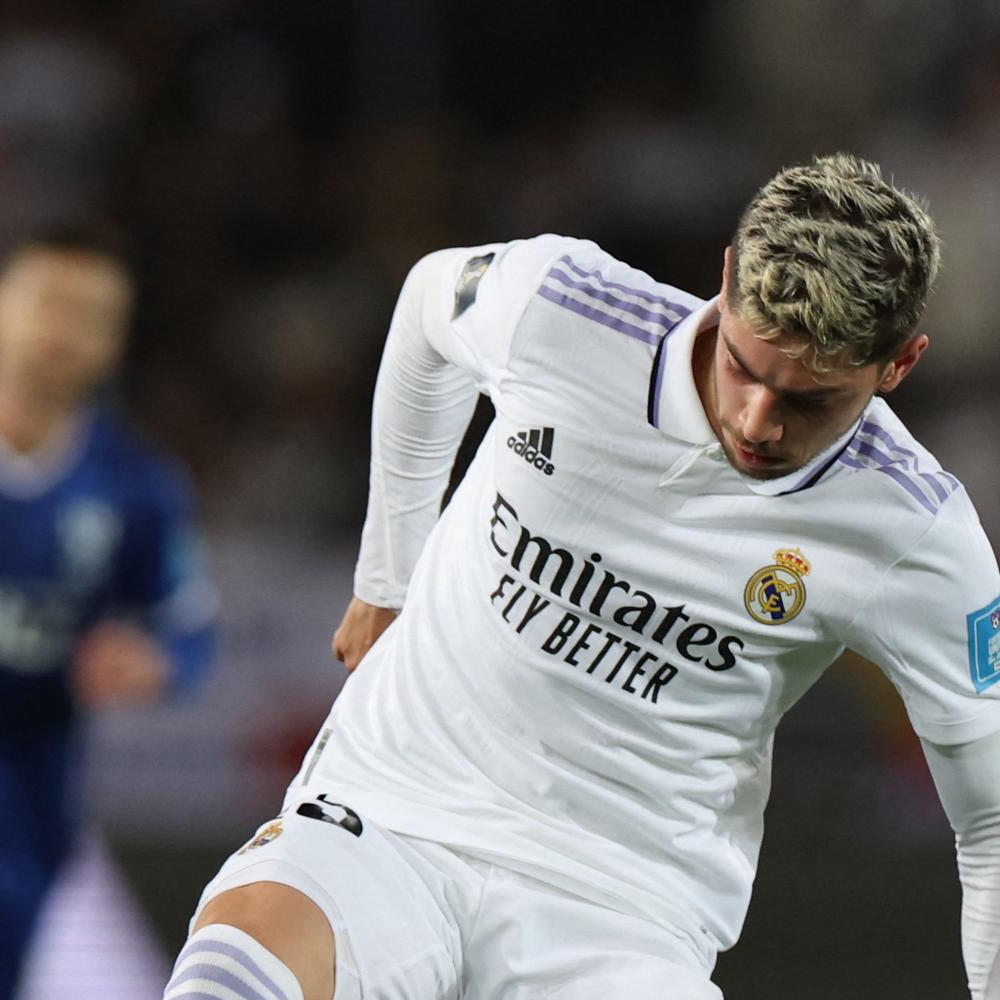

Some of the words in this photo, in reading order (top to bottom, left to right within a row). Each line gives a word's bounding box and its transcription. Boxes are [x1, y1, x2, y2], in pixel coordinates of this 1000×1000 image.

[507, 436, 555, 476] adidas
[490, 491, 745, 672] Emirates
[490, 573, 552, 634] FLY
[541, 612, 679, 704] BETTER
